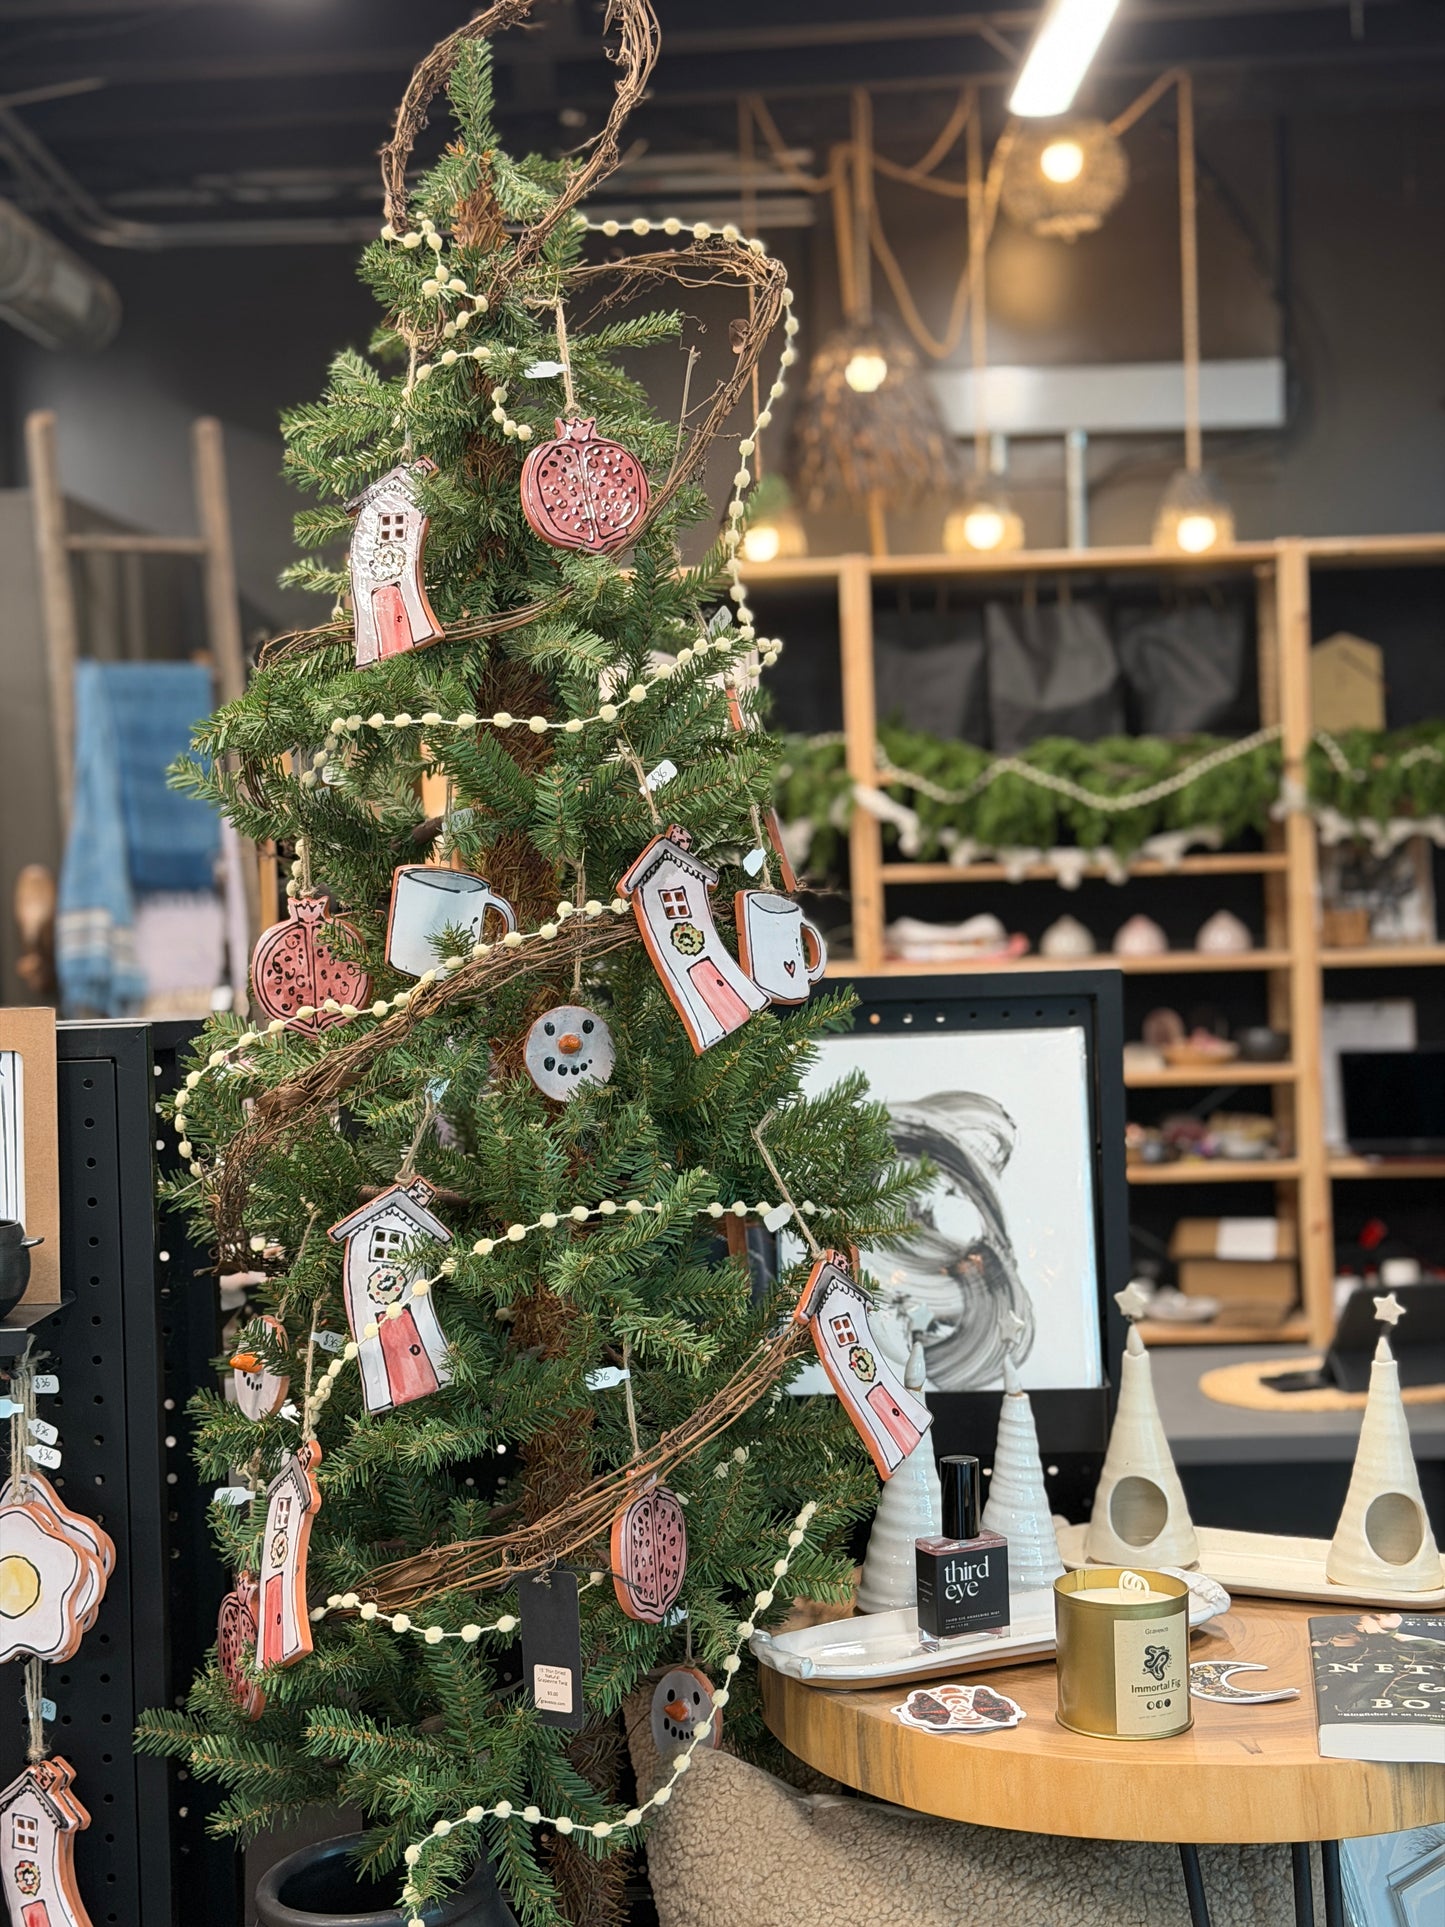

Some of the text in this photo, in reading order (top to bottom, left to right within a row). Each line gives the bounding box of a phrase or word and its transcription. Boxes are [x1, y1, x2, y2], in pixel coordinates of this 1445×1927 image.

[38, 1447, 54, 1461] $36
[944, 1555, 990, 1584] third
[945, 1581, 980, 1604] eye
[1328, 1663, 1445, 1675] NET
[1131, 1679, 1181, 1694] Immortal Fig
[1417, 1682, 1445, 1693] &
[1370, 1698, 1445, 1711] BO
